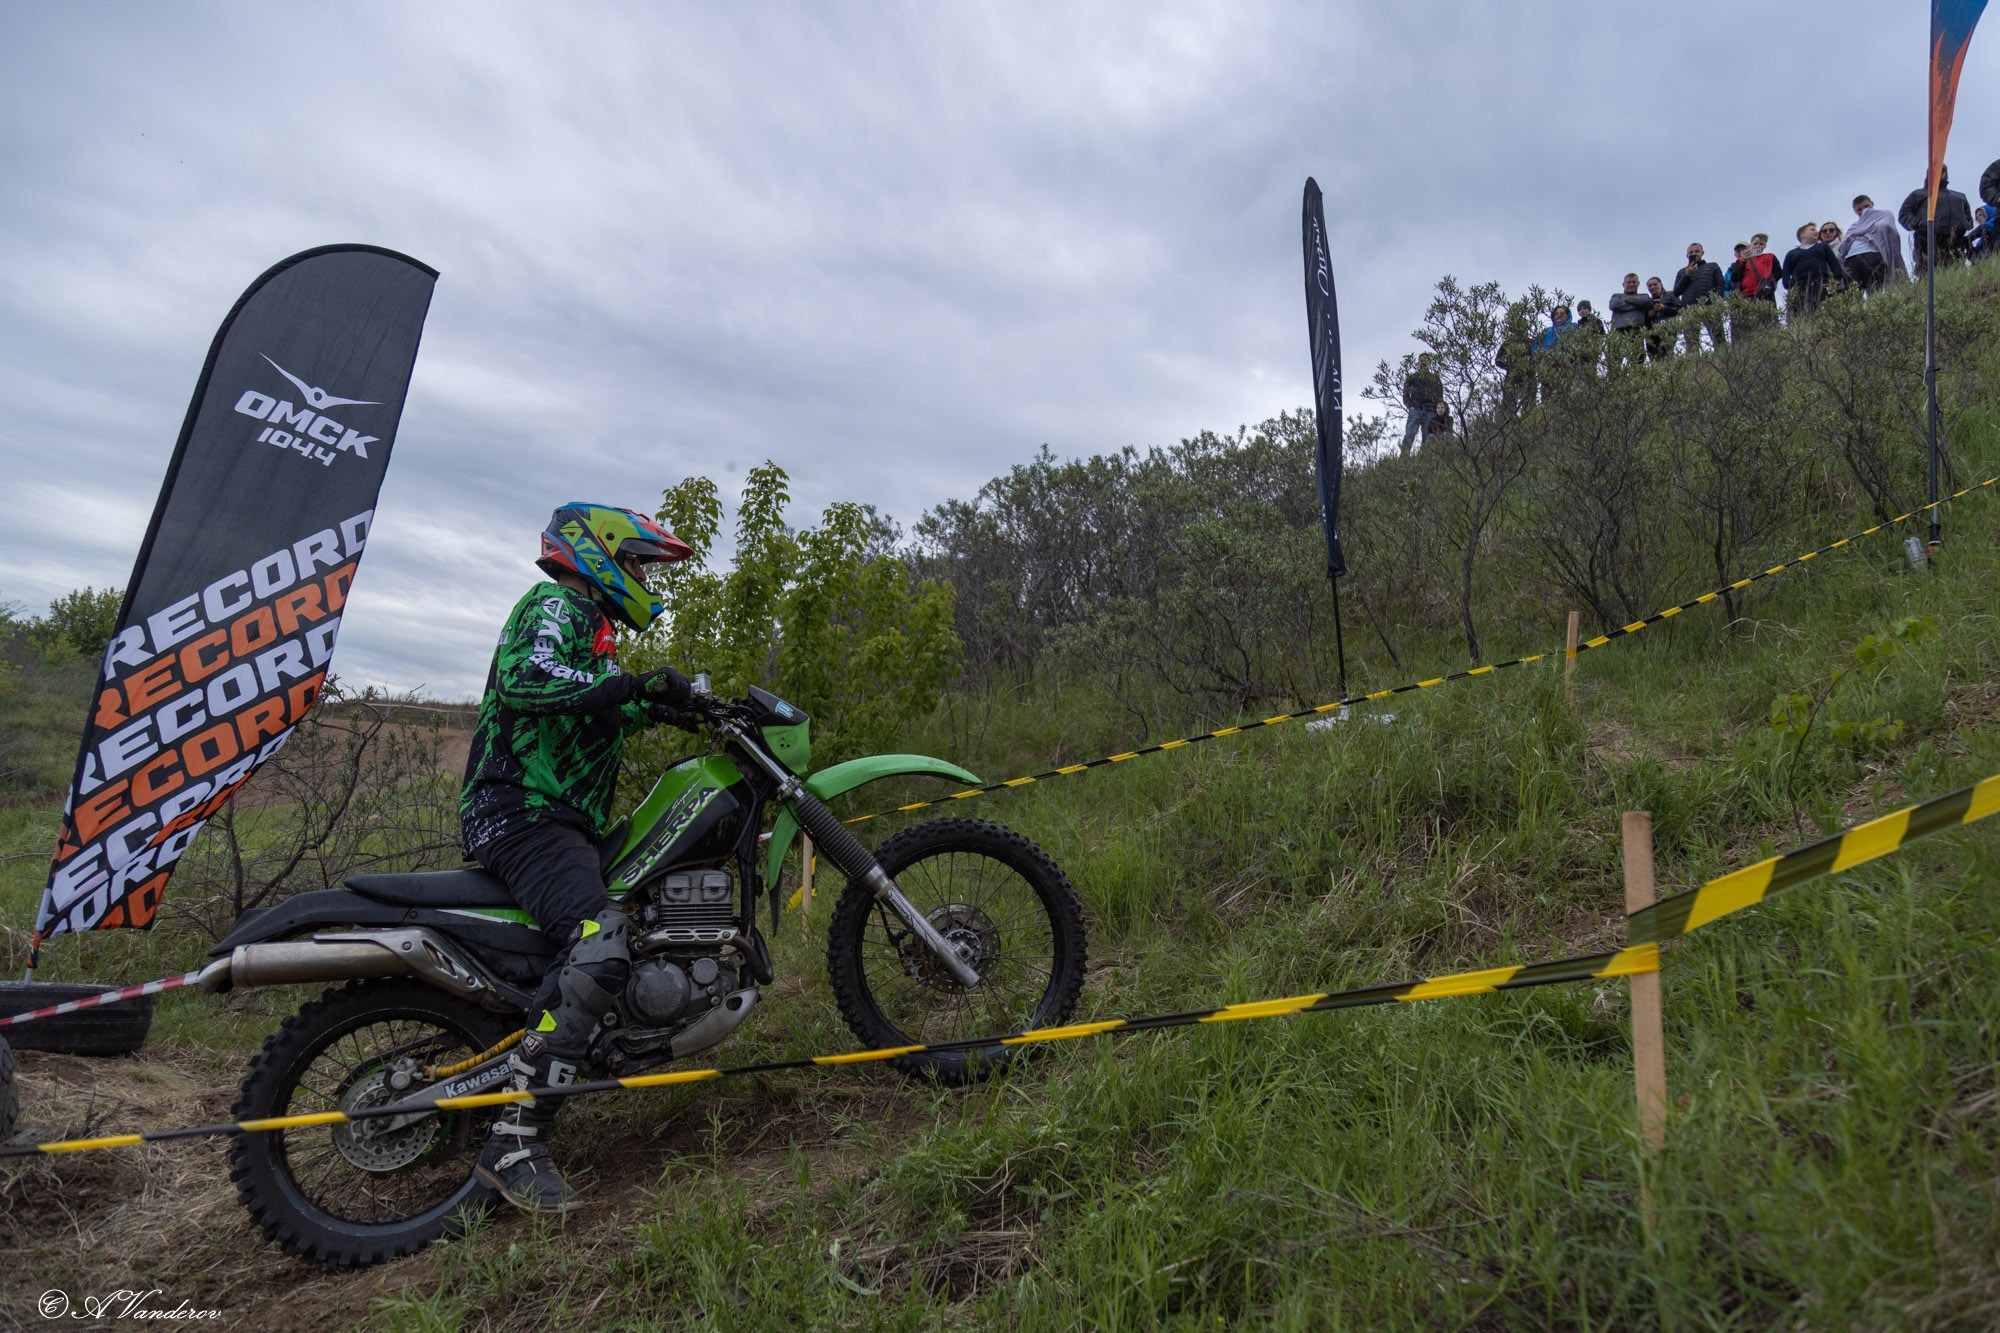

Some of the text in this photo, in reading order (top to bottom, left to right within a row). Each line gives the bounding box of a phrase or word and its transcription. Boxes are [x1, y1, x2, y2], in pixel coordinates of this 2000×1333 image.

[94, 562, 358, 730] RECORD
[104, 509, 374, 681] RECORD
[59, 671, 325, 863] ECORD
[621, 786, 719, 886] SHERPA
[445, 1057, 514, 1098] Kawasa
